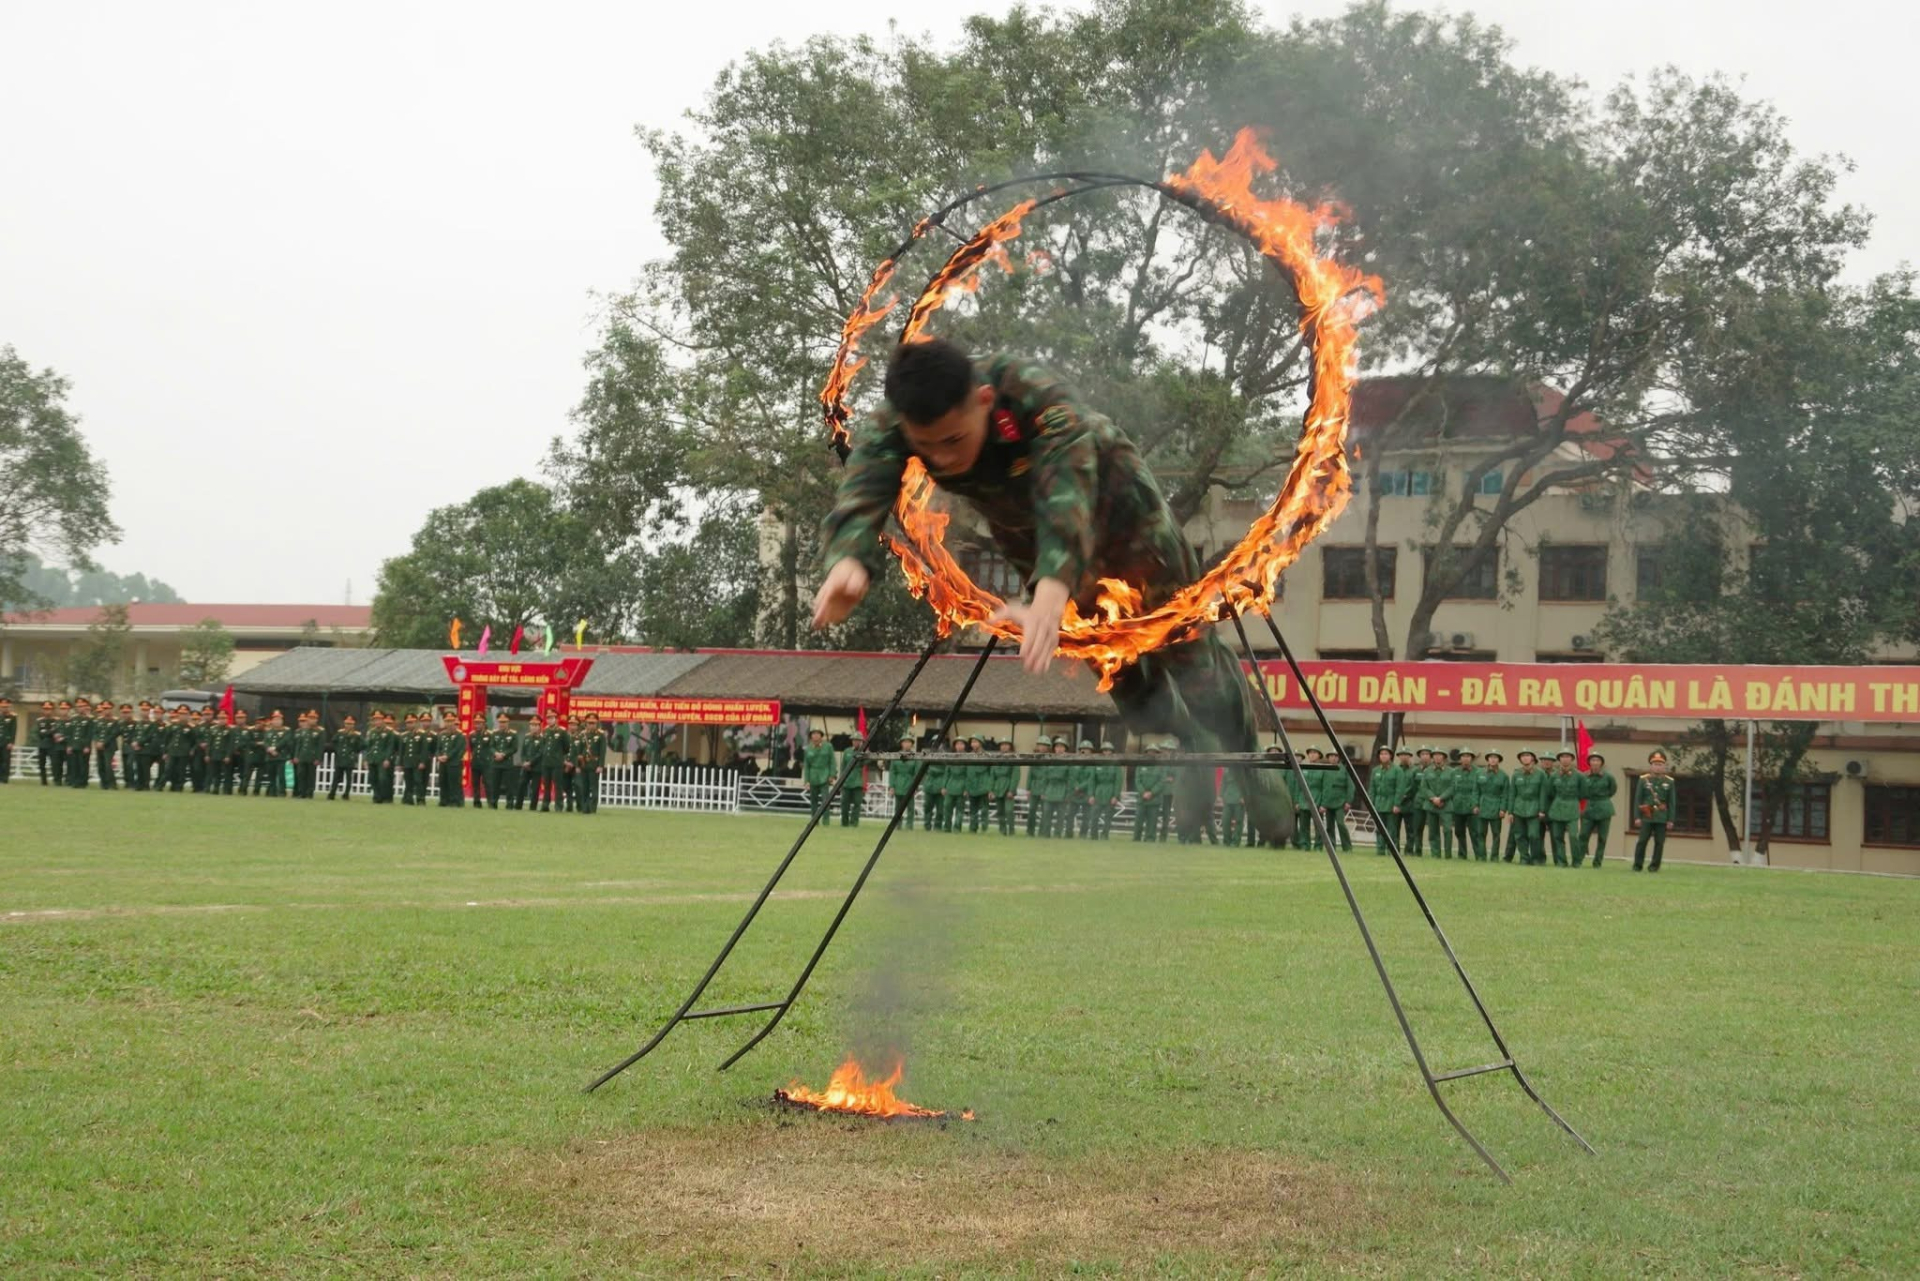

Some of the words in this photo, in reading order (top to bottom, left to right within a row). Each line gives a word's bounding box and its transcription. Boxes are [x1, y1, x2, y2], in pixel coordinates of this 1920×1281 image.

[1358, 671, 1428, 705] DÂN
[1438, 689, 1449, 697] -
[1461, 674, 1507, 706] ĐÃ
[1518, 678, 1564, 707] RA
[1574, 674, 1677, 711] QUÂN
[1688, 675, 1734, 711] LÀ
[1745, 676, 1857, 713] ĐÁNH
[1868, 682, 1920, 714] TH
